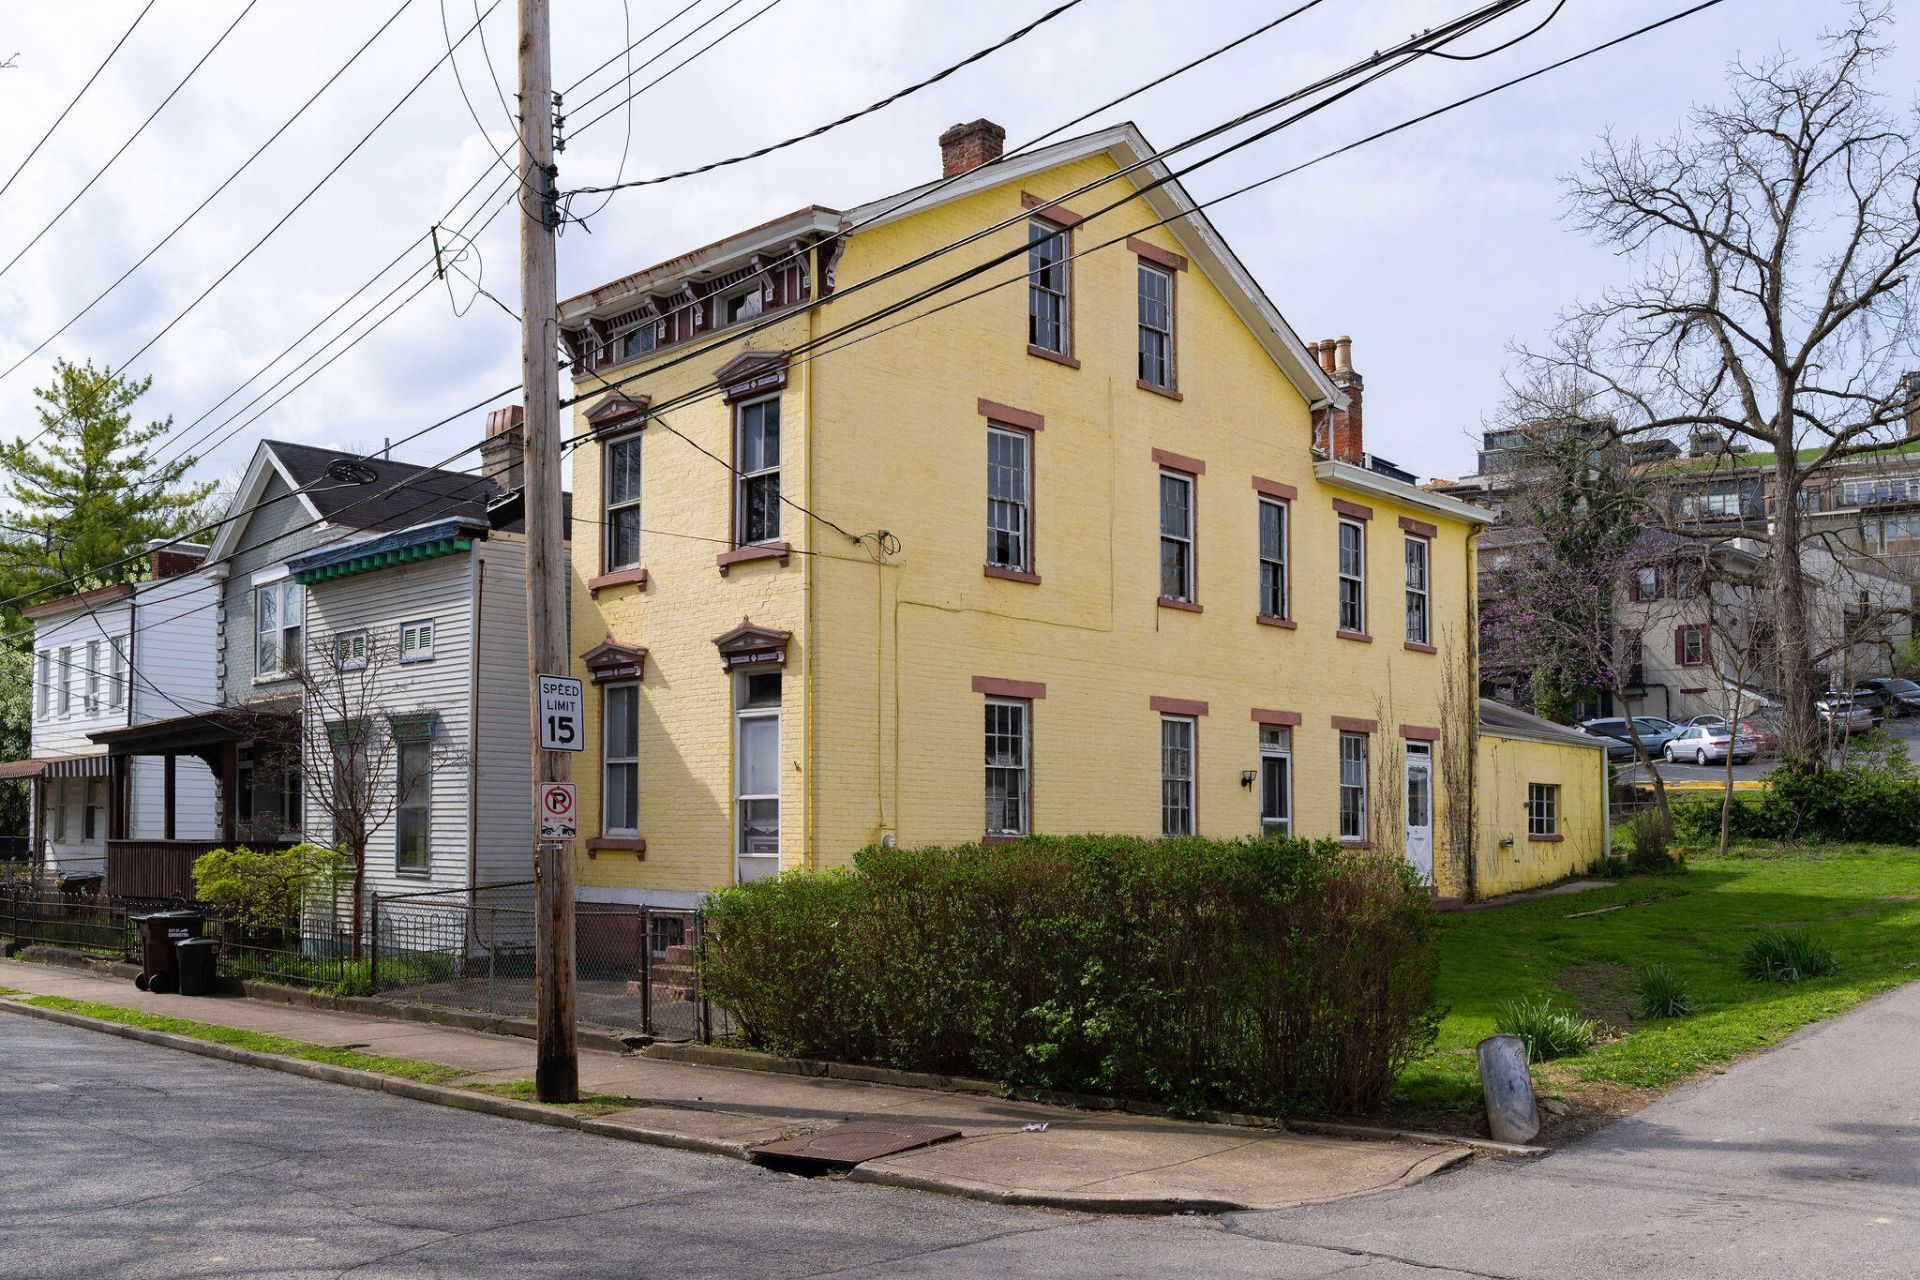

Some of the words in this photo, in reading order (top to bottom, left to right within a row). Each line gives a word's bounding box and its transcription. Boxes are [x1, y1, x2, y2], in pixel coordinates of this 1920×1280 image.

[543, 683, 579, 697] SPEED
[547, 699, 576, 712] LIMIT
[548, 715, 575, 743] 15
